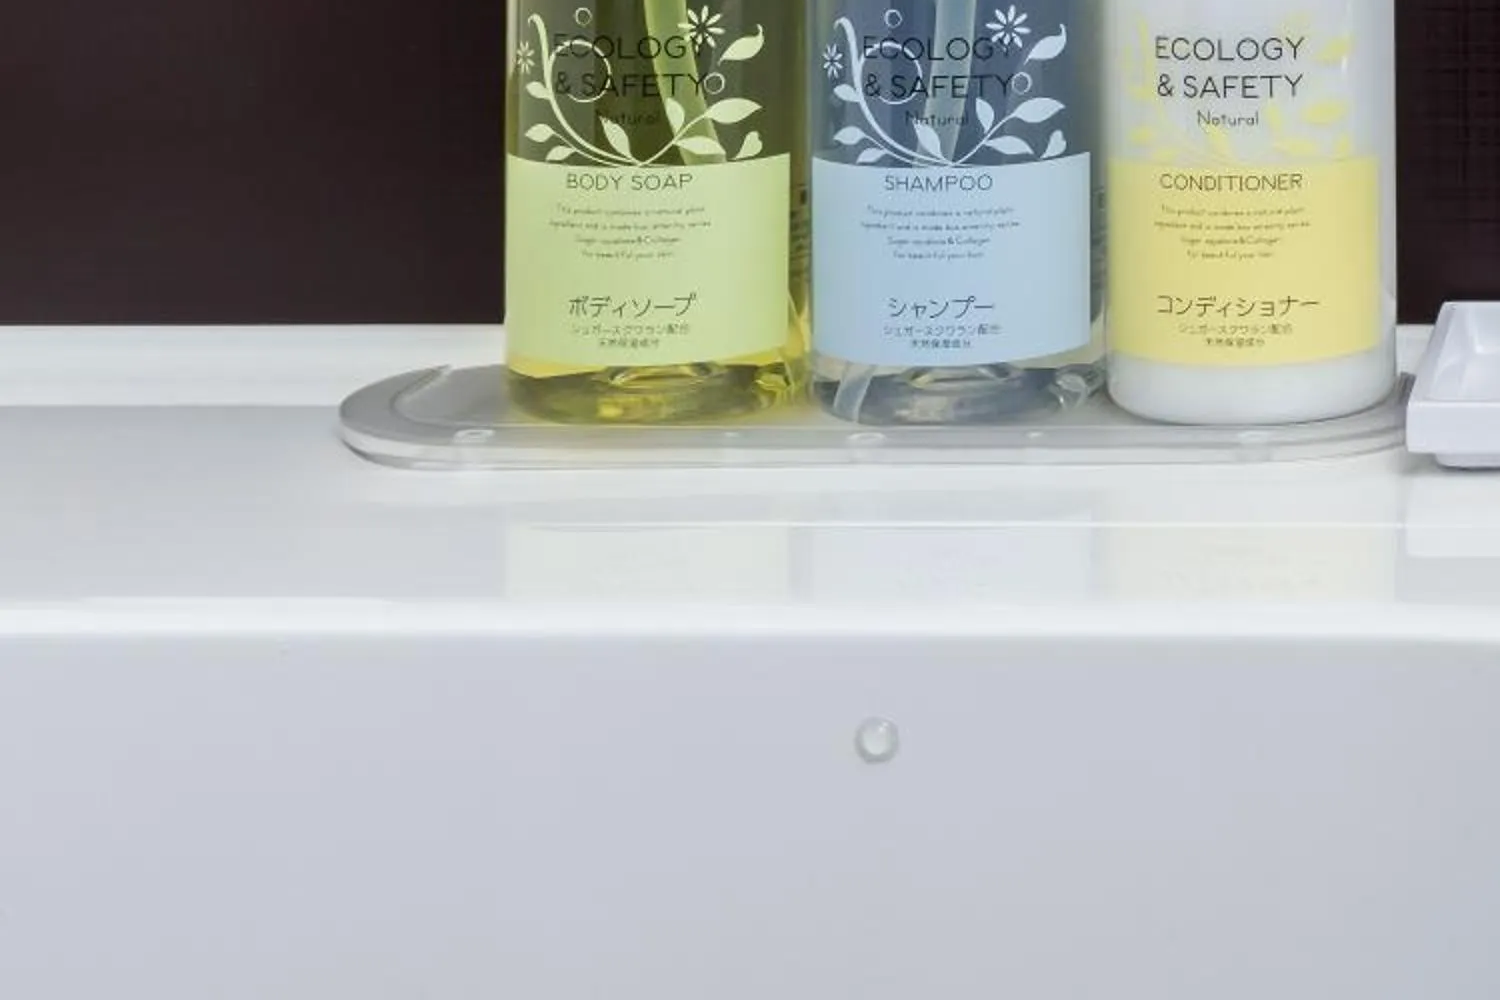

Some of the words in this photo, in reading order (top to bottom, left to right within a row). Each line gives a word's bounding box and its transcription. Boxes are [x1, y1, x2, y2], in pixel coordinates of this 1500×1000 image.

[1155, 36, 1305, 61] ECOLOGY
[556, 71, 571, 95] &
[581, 72, 708, 98] SAFETY
[864, 73, 880, 97] &
[890, 73, 1015, 99] SAFETY
[1157, 73, 1174, 98] &
[1183, 74, 1303, 99] SAFETY
[1197, 110, 1259, 126] Natural
[566, 173, 623, 192] BODY
[630, 173, 693, 192] SOAP
[885, 174, 994, 192] SHAMPOO
[1159, 173, 1303, 192] CONDITIONER
[568, 291, 698, 318] ボディソープ
[889, 295, 995, 319] シャンプー
[1157, 295, 1320, 317] コンディショナー
